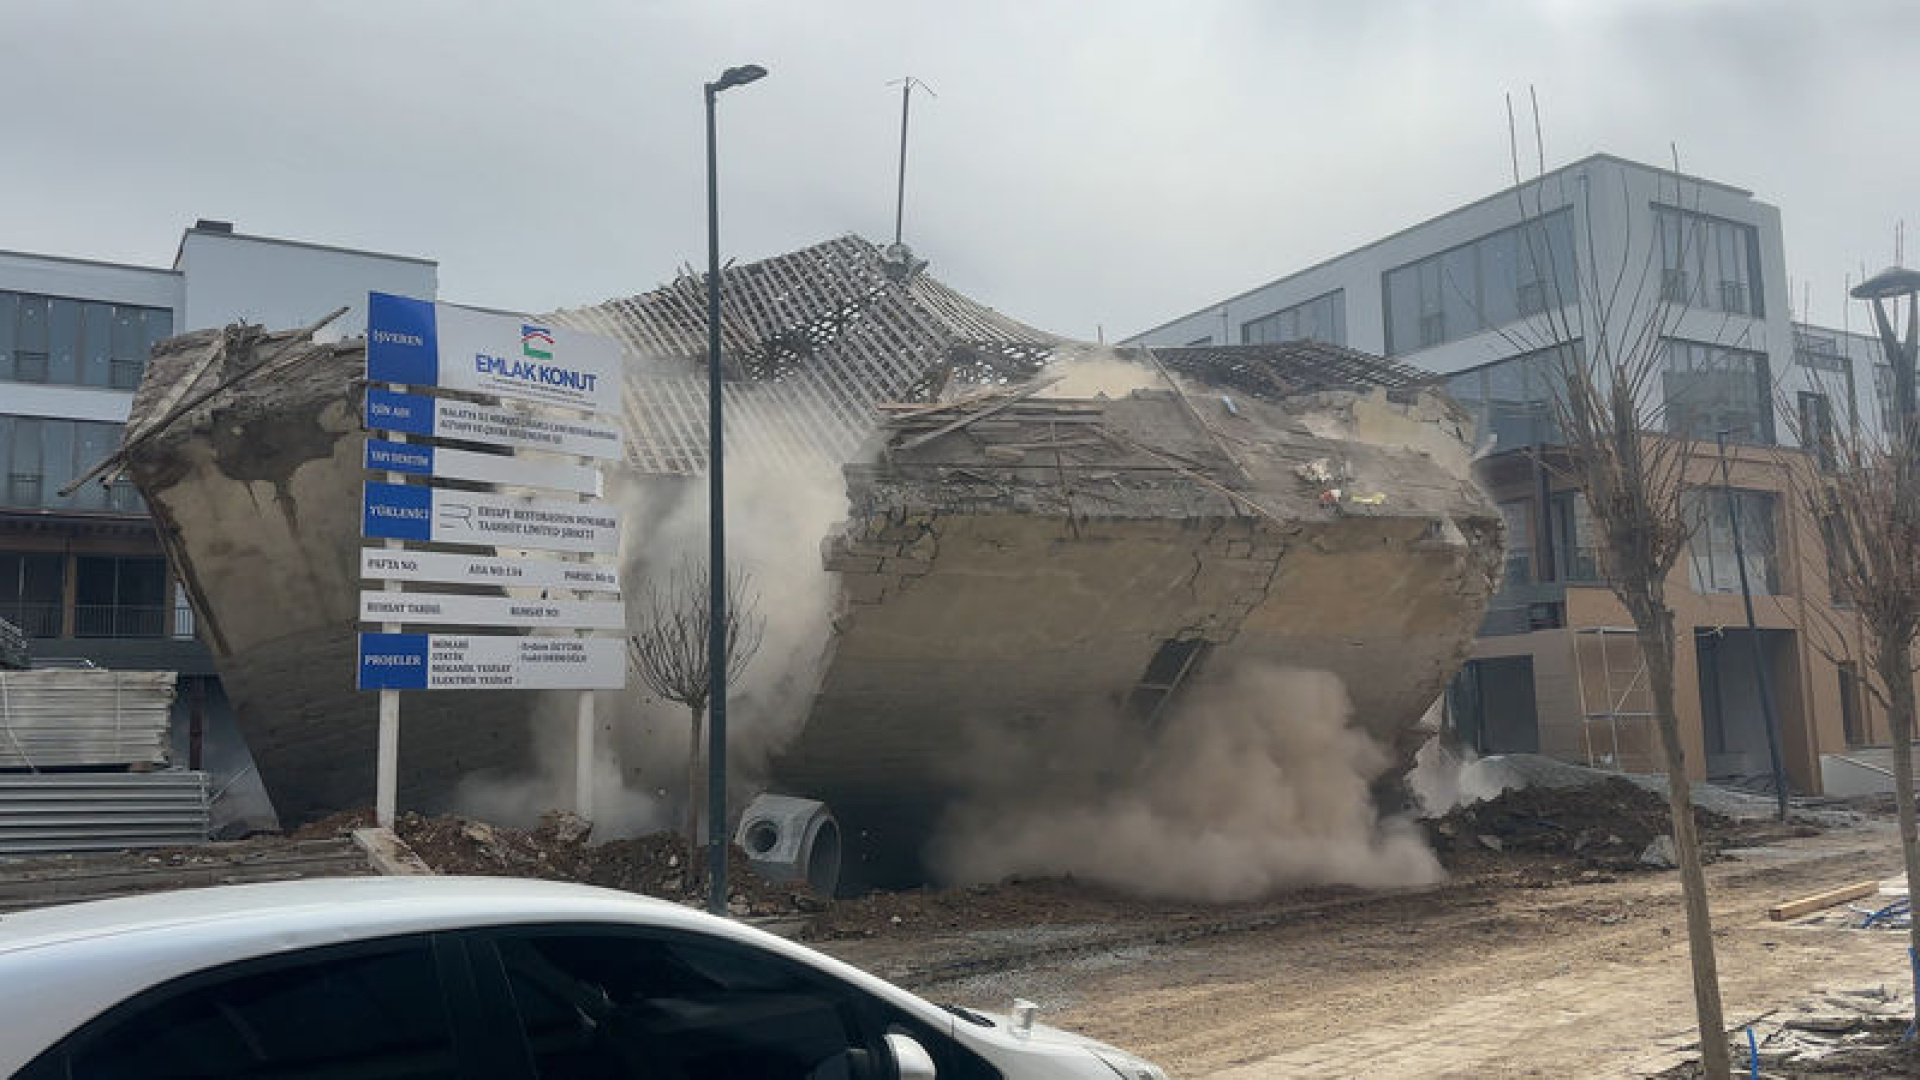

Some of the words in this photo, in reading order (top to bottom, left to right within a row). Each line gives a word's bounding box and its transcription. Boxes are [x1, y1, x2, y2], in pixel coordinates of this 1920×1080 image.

[476, 353, 537, 382] EMLAK
[538, 365, 597, 392] KONUT
[364, 654, 422, 667] PROJELER
